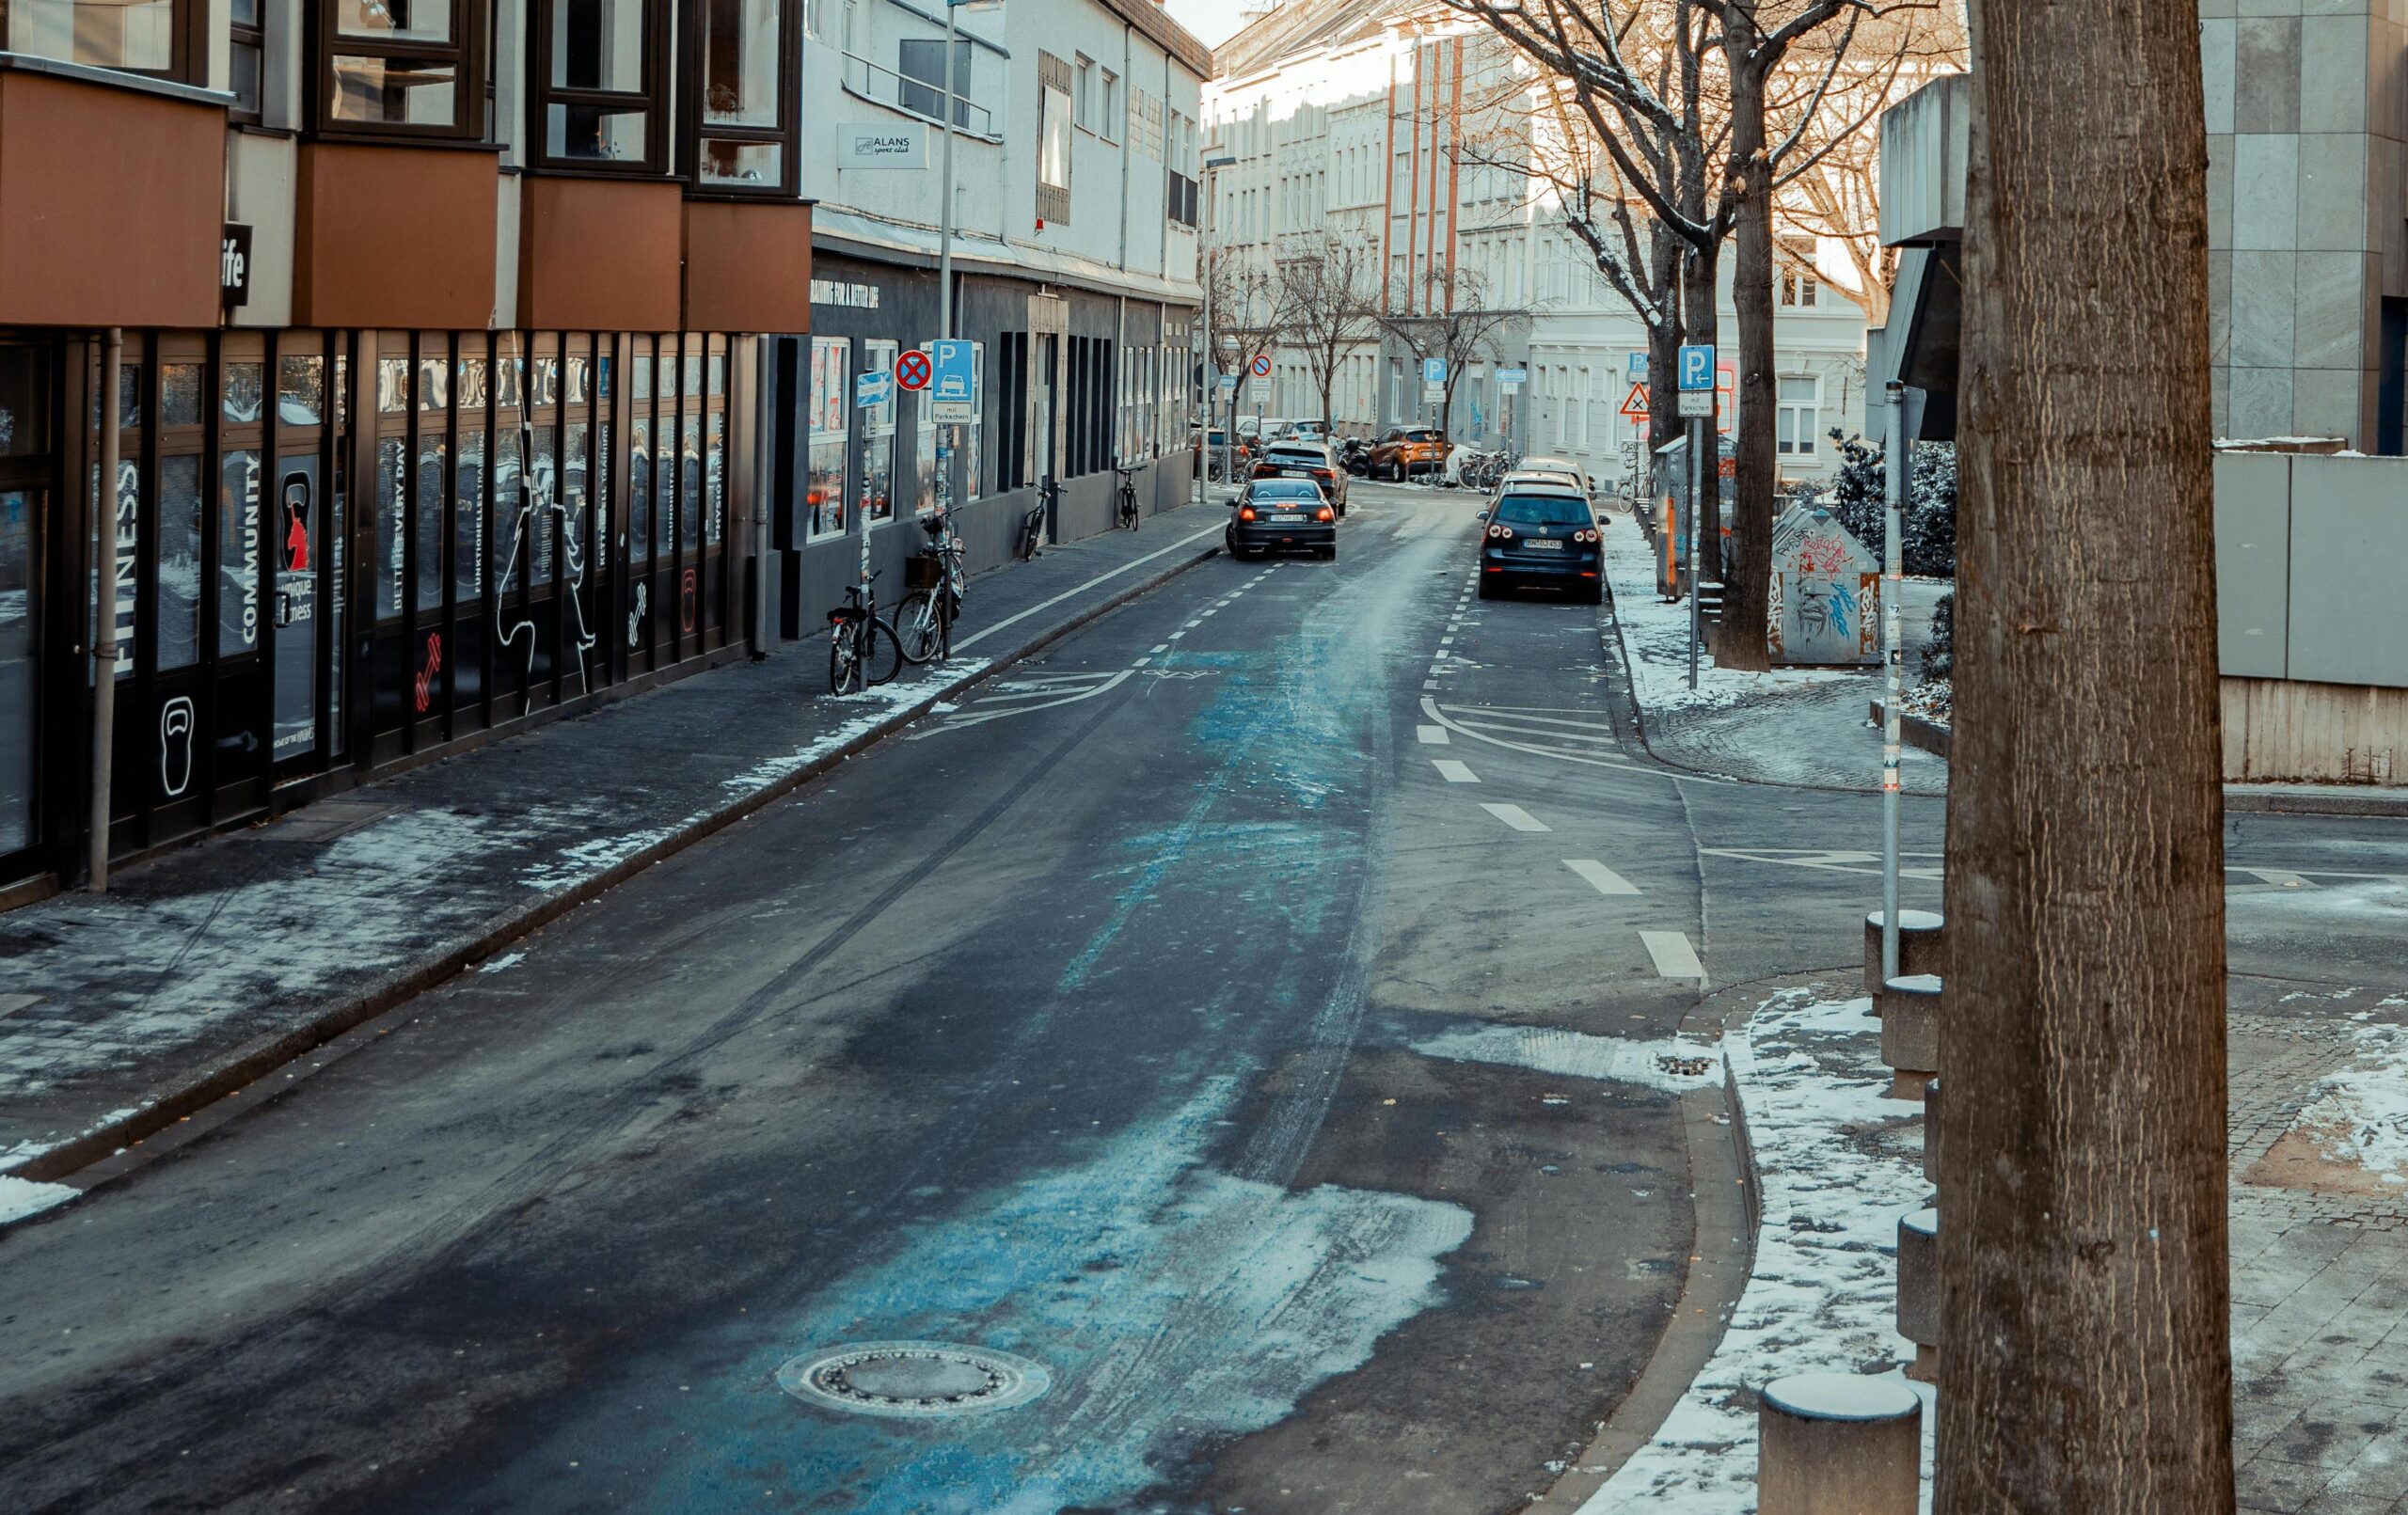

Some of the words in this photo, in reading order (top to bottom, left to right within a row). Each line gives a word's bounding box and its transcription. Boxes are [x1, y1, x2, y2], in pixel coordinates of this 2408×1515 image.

[873, 137, 910, 147] ALANS
[874, 147, 893, 155] sport
[222, 239, 245, 287] ife
[834, 281, 845, 306] FOR
[845, 283, 850, 306] A
[850, 283, 868, 308] BETTER
[868, 286, 879, 308] LIFE
[939, 345, 957, 368] P
[1430, 361, 1441, 378] P
[1687, 351, 1705, 385] P
[395, 441, 405, 479] DAY
[394, 482, 405, 544] EVERY
[243, 455, 260, 644] COMMUNITY
[475, 492, 483, 593] FUNKTIONELLES
[394, 544, 404, 610] BETTER
